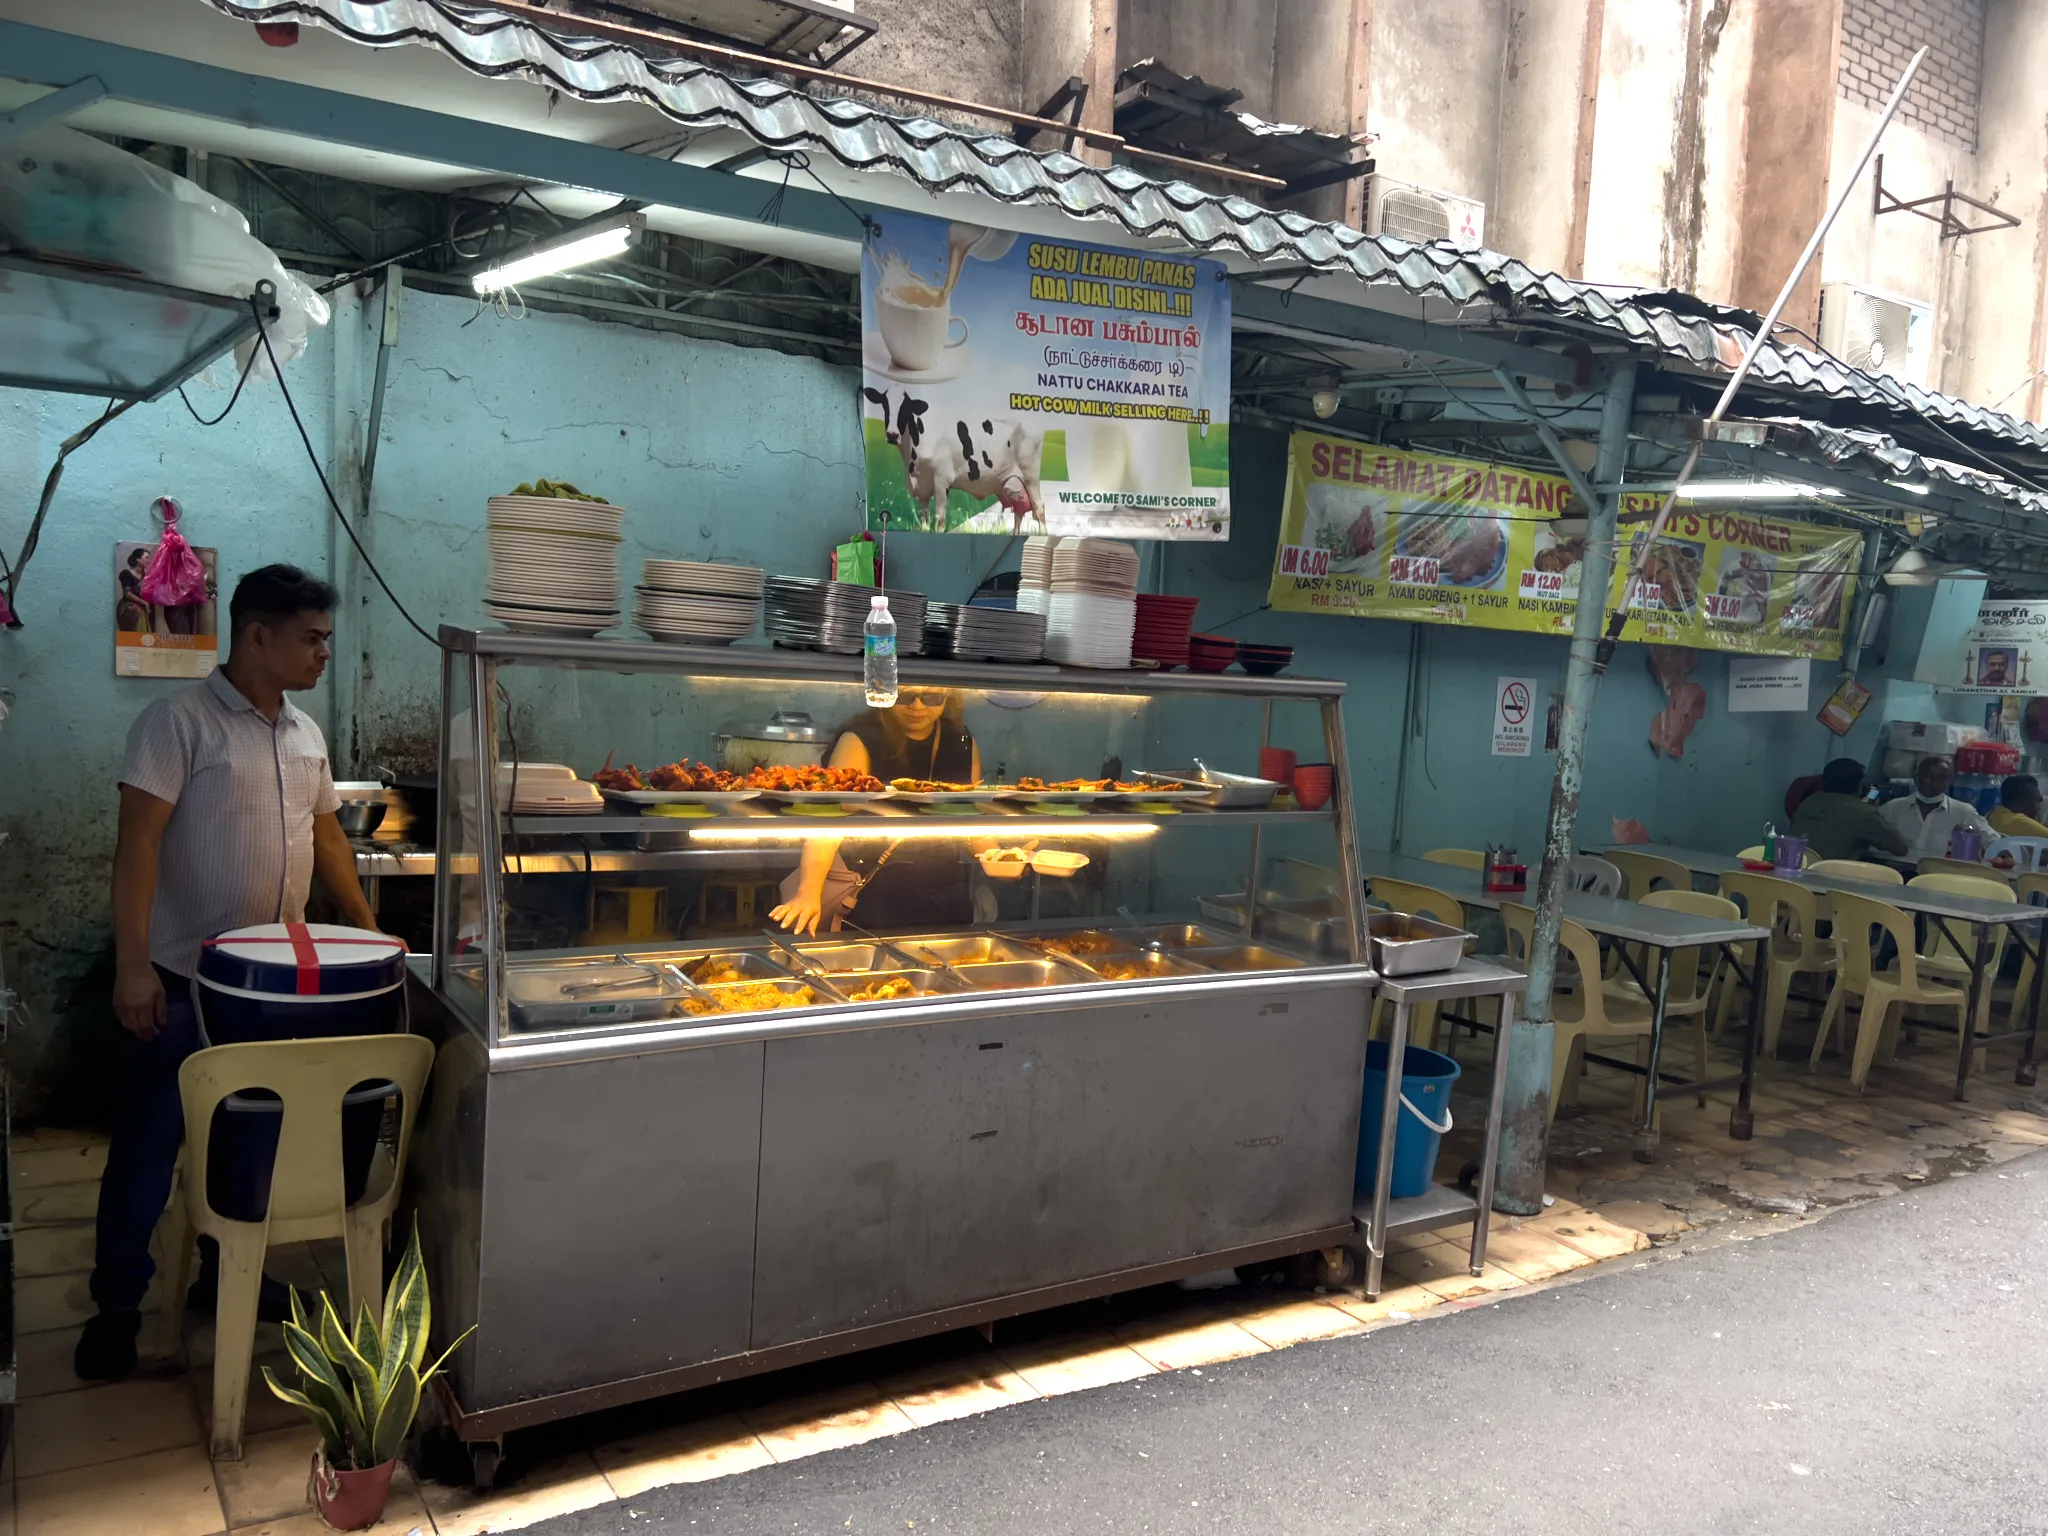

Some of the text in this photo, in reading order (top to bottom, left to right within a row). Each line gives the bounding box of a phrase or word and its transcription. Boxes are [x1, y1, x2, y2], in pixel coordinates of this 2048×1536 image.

[1028, 242, 1196, 289] SUSU LEMBU PANAS
[1030, 274, 1069, 303] ADA
[1070, 280, 1111, 308] JUAL
[1016, 311, 1200, 348] சூடான பசும்பால்
[1037, 373, 1189, 398] NATTU CHAKKARAI TEA
[1010, 393, 1042, 411] HOT
[1043, 398, 1077, 414] COW
[1078, 400, 1112, 416] MILK
[1112, 403, 1167, 420] SELLING
[1312, 442, 1573, 513] SELAMAT DATANG
[1058, 492, 1217, 508] WELCOME TO SAMI'S CORNER
[1707, 514, 1793, 552] CORNER
[1301, 549, 1329, 576] 6.00
[1390, 558, 1409, 581] RM
[1293, 577, 1324, 590] NASI
[1335, 579, 1375, 597] SAYUR
[1520, 573, 1561, 590] RM 12.00
[1388, 586, 1508, 608] AYAM GORENG + 1 SAYUR
[1518, 598, 1539, 611] NASI
